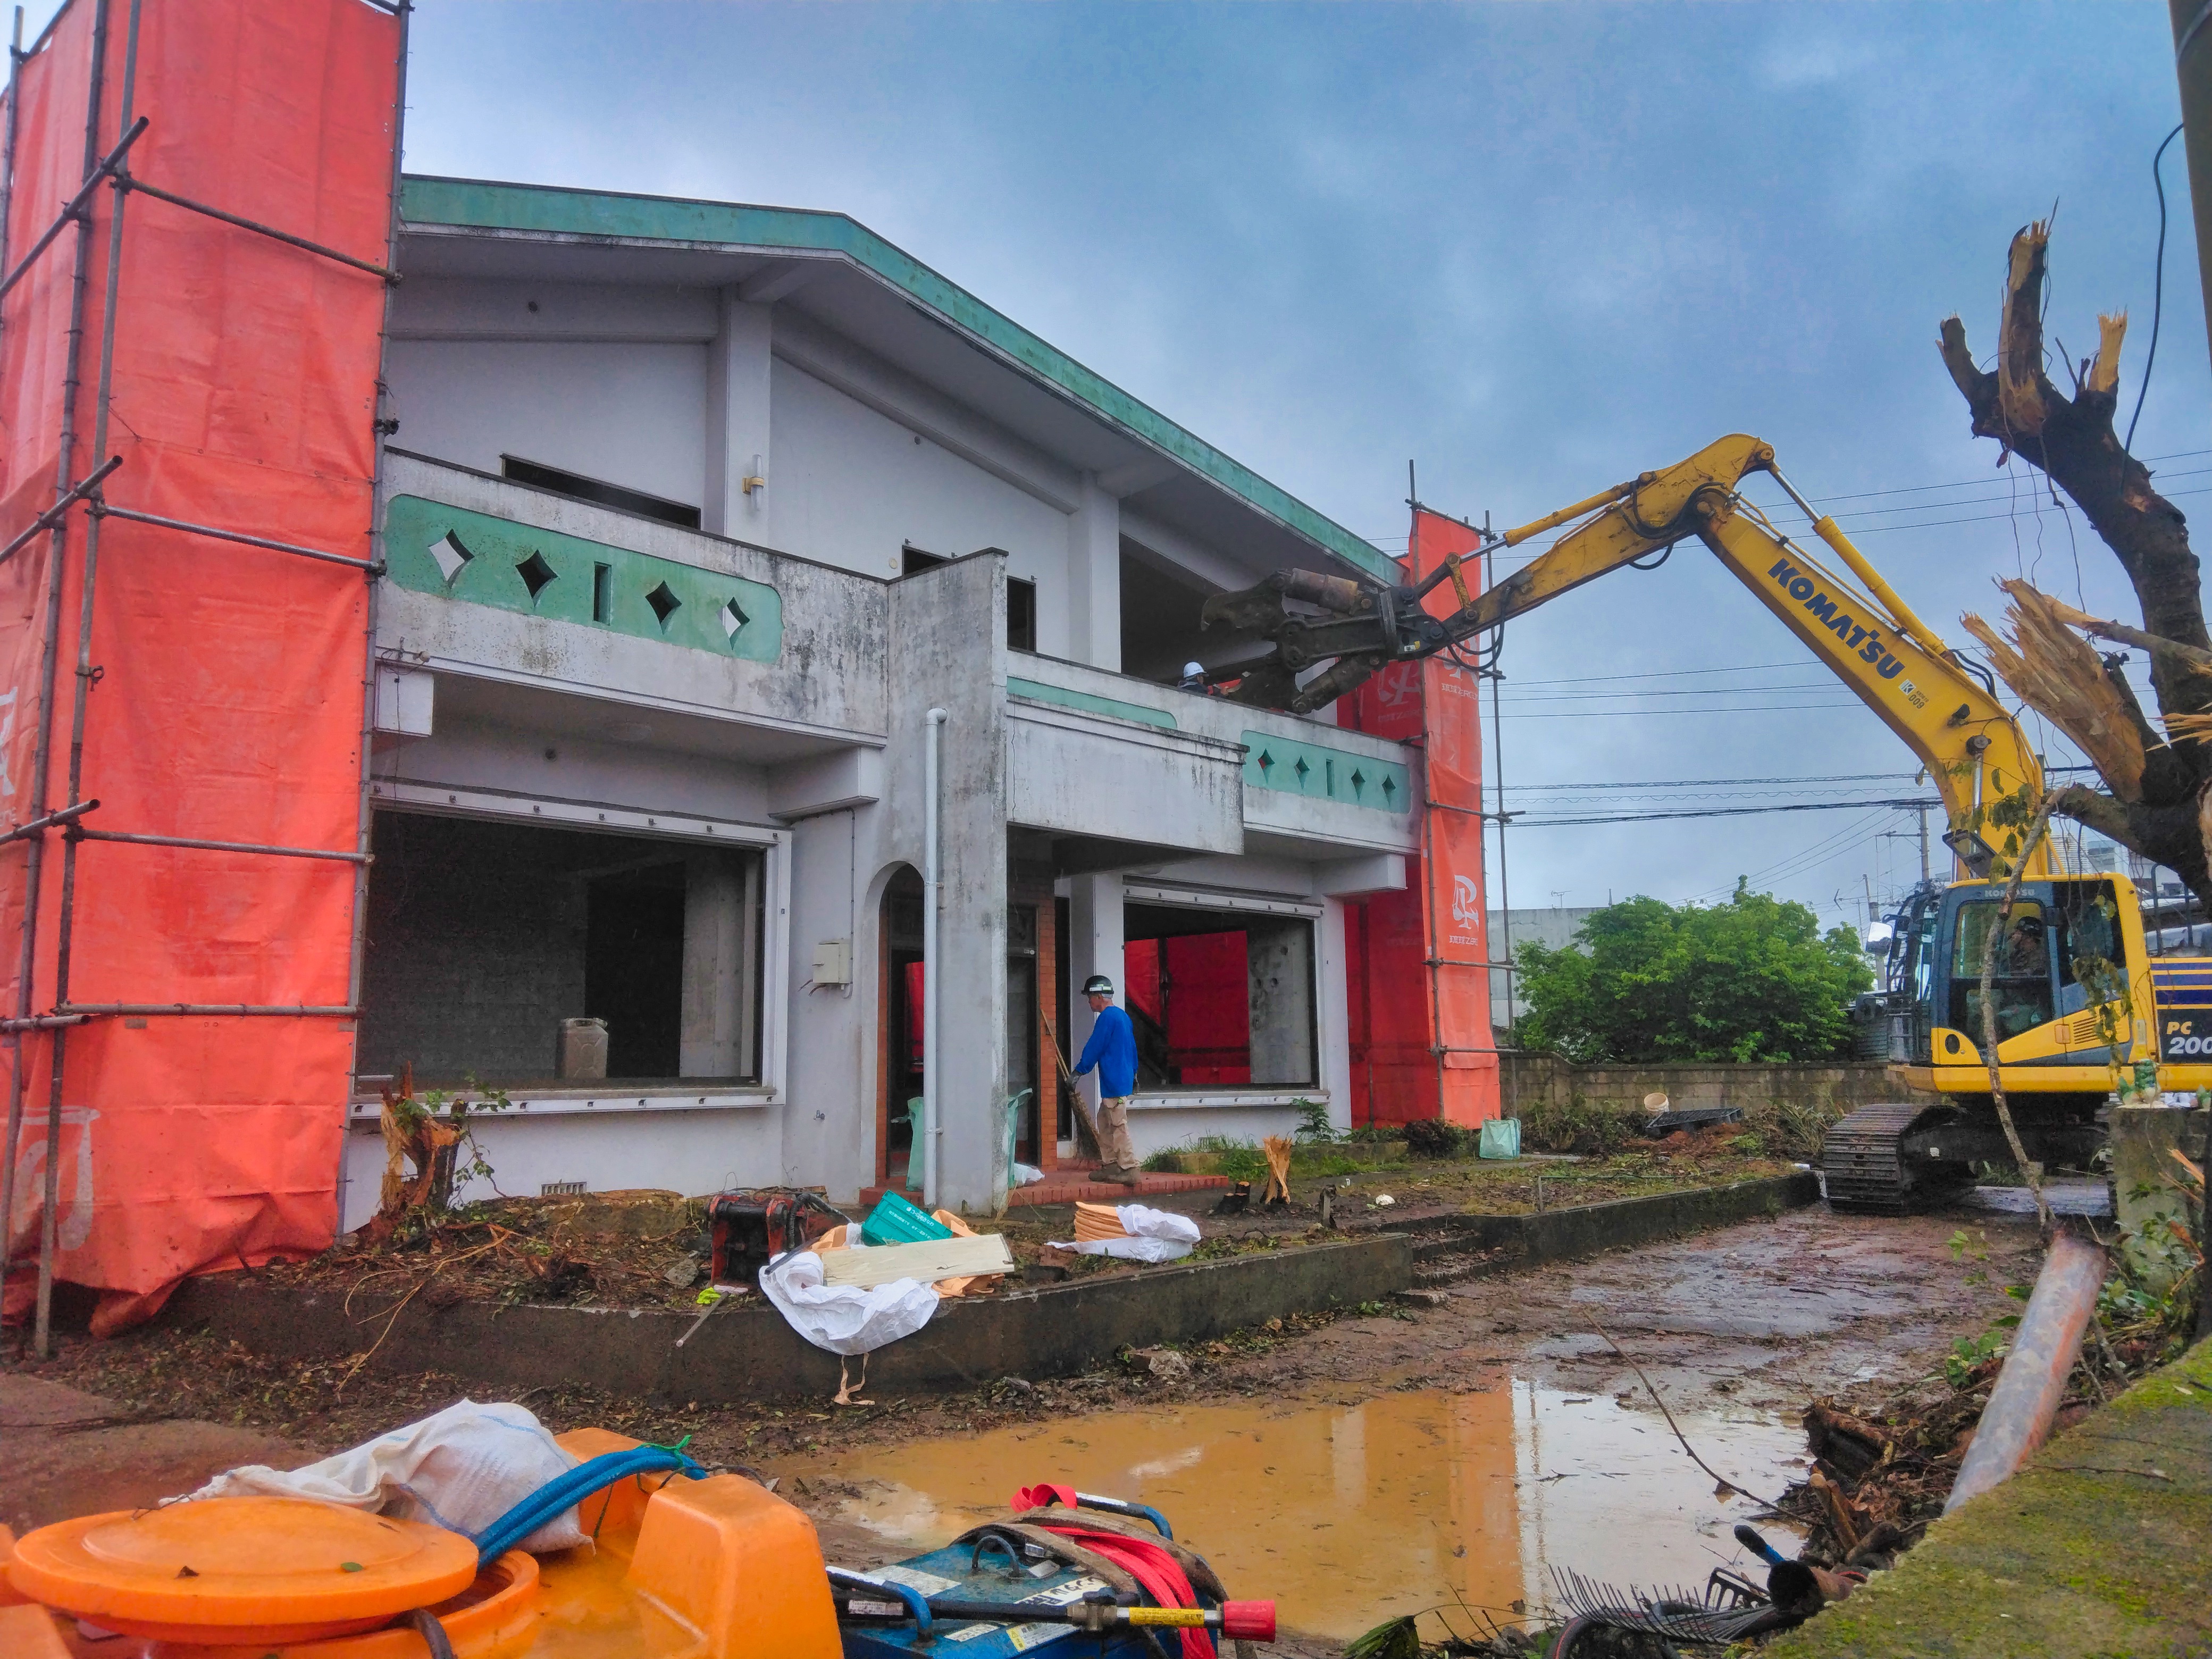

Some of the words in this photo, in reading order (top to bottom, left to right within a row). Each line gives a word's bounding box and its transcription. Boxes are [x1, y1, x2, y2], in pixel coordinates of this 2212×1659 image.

[1767, 558, 1905, 679] KOMATSU
[1908, 694, 1925, 709] 009
[2166, 1021, 2192, 1035] PC
[2168, 1036, 2212, 1054] 200
